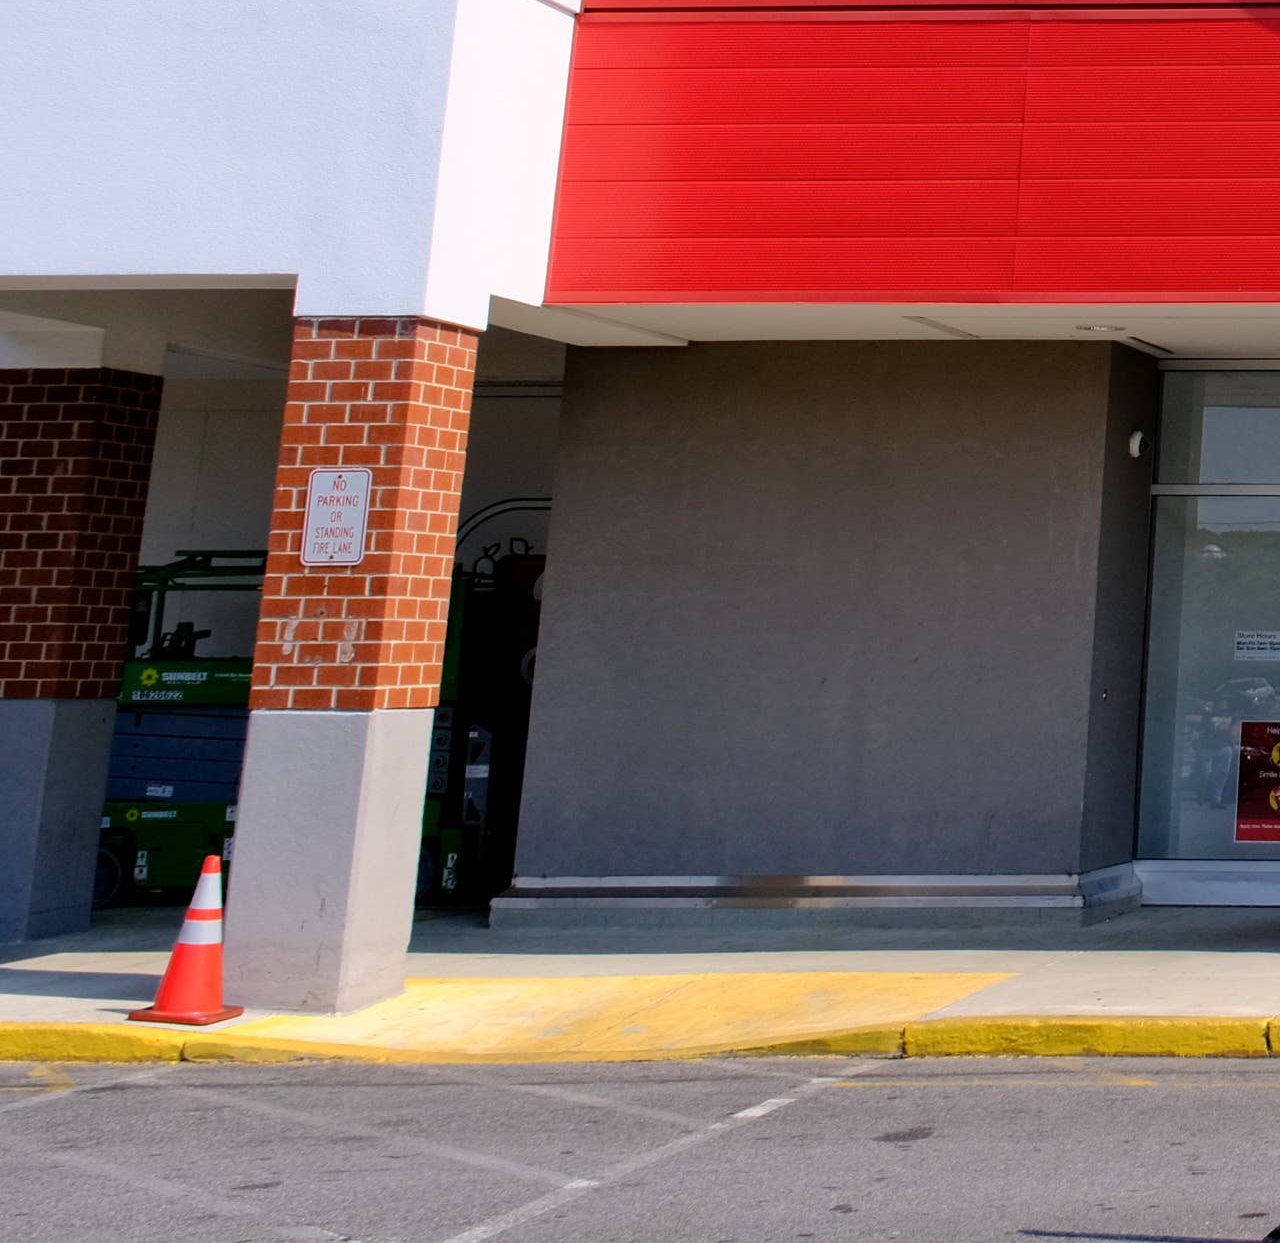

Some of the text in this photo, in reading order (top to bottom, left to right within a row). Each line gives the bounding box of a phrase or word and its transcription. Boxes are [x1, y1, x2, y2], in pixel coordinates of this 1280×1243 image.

[332, 479, 347, 491] NO
[317, 495, 360, 507] PARKING
[330, 511, 343, 523] OR
[314, 526, 355, 538] STANDING
[312, 542, 353, 554] FIRE LANE
[161, 671, 209, 682] SUNBELT
[1259, 770, 1278, 779] Smile
